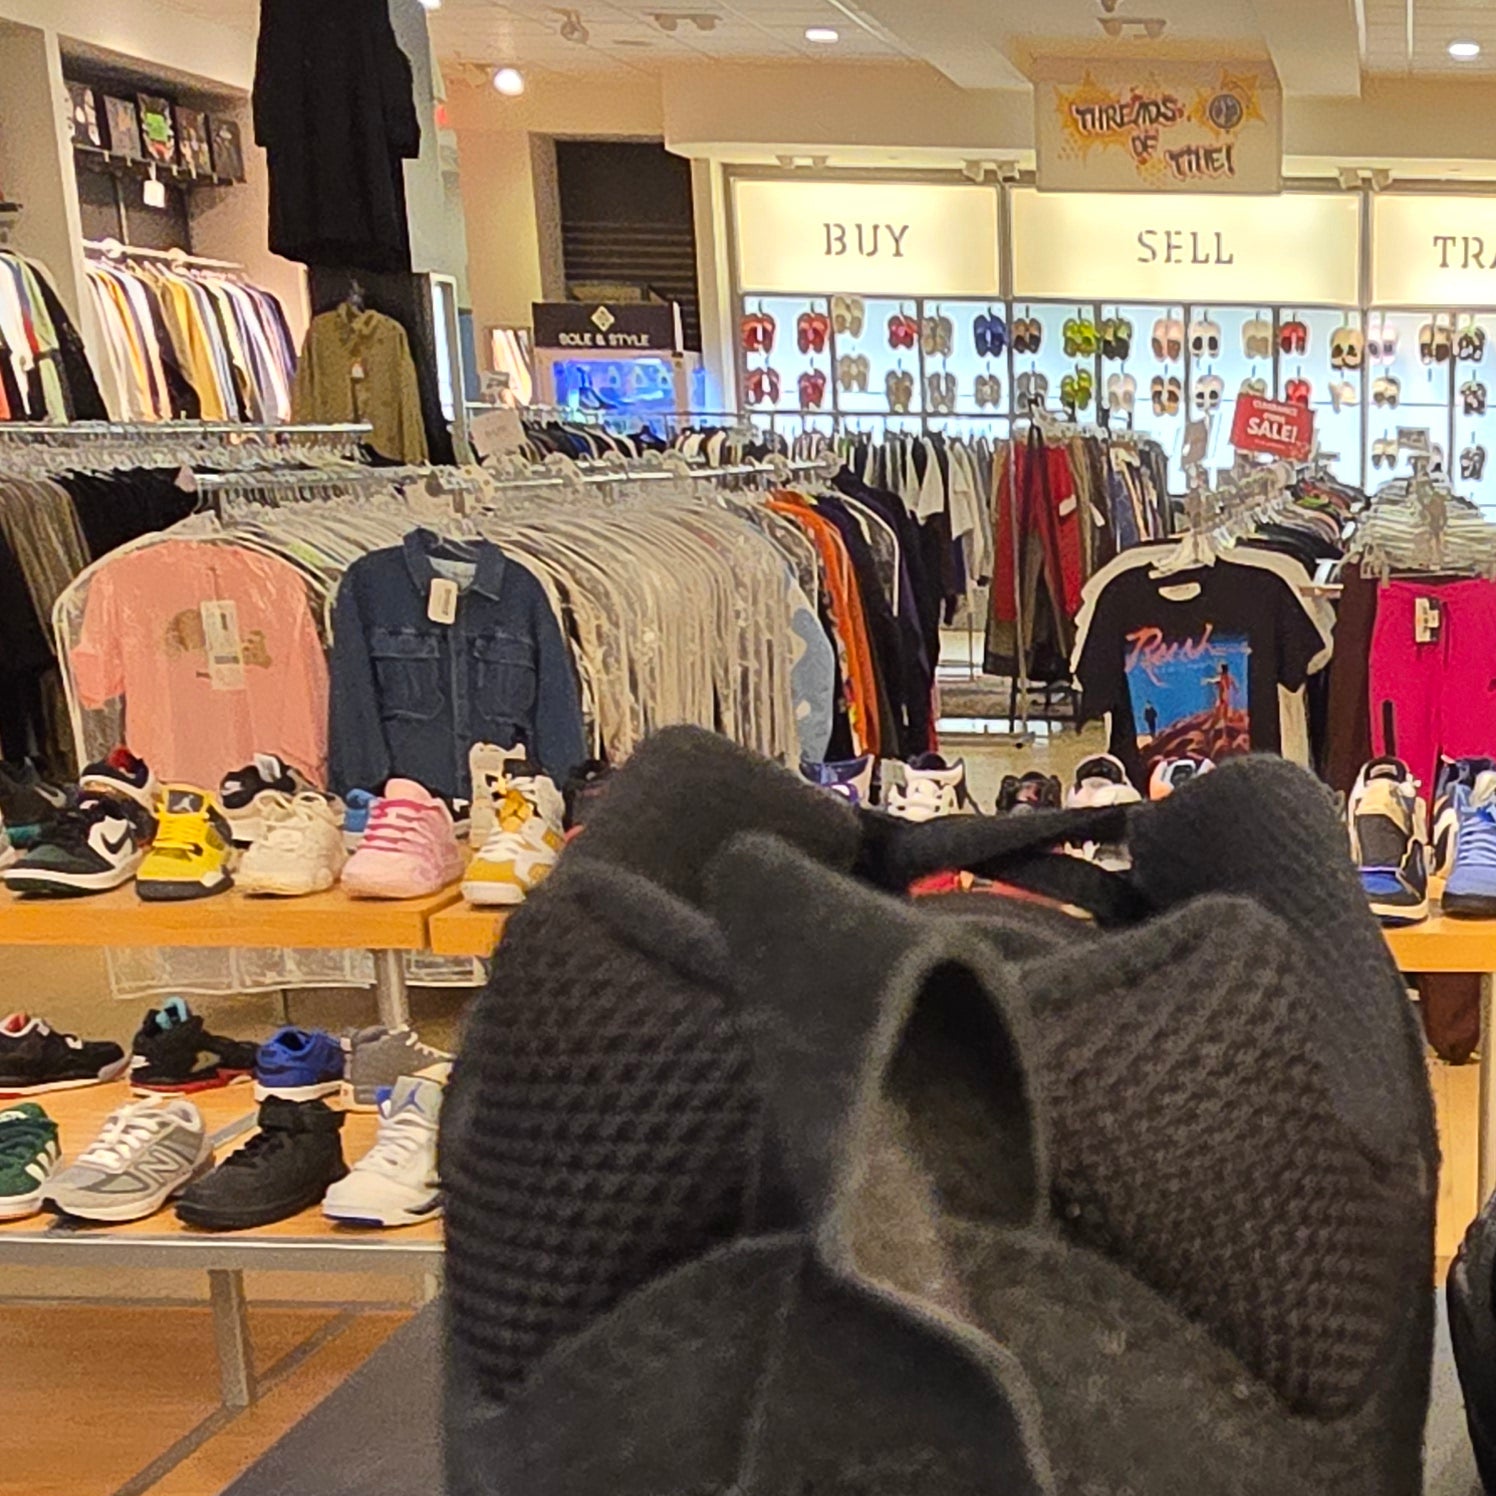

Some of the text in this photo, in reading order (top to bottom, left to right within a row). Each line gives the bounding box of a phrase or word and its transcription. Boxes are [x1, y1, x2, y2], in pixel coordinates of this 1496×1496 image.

[1072, 97, 1178, 131] THREADS
[1131, 134, 1158, 158] OF
[823, 223, 909, 257] BUY
[1137, 229, 1234, 265] SELL
[558, 332, 593, 346] SOLE
[608, 333, 650, 347] STYLE
[1247, 416, 1298, 443] SALE!
